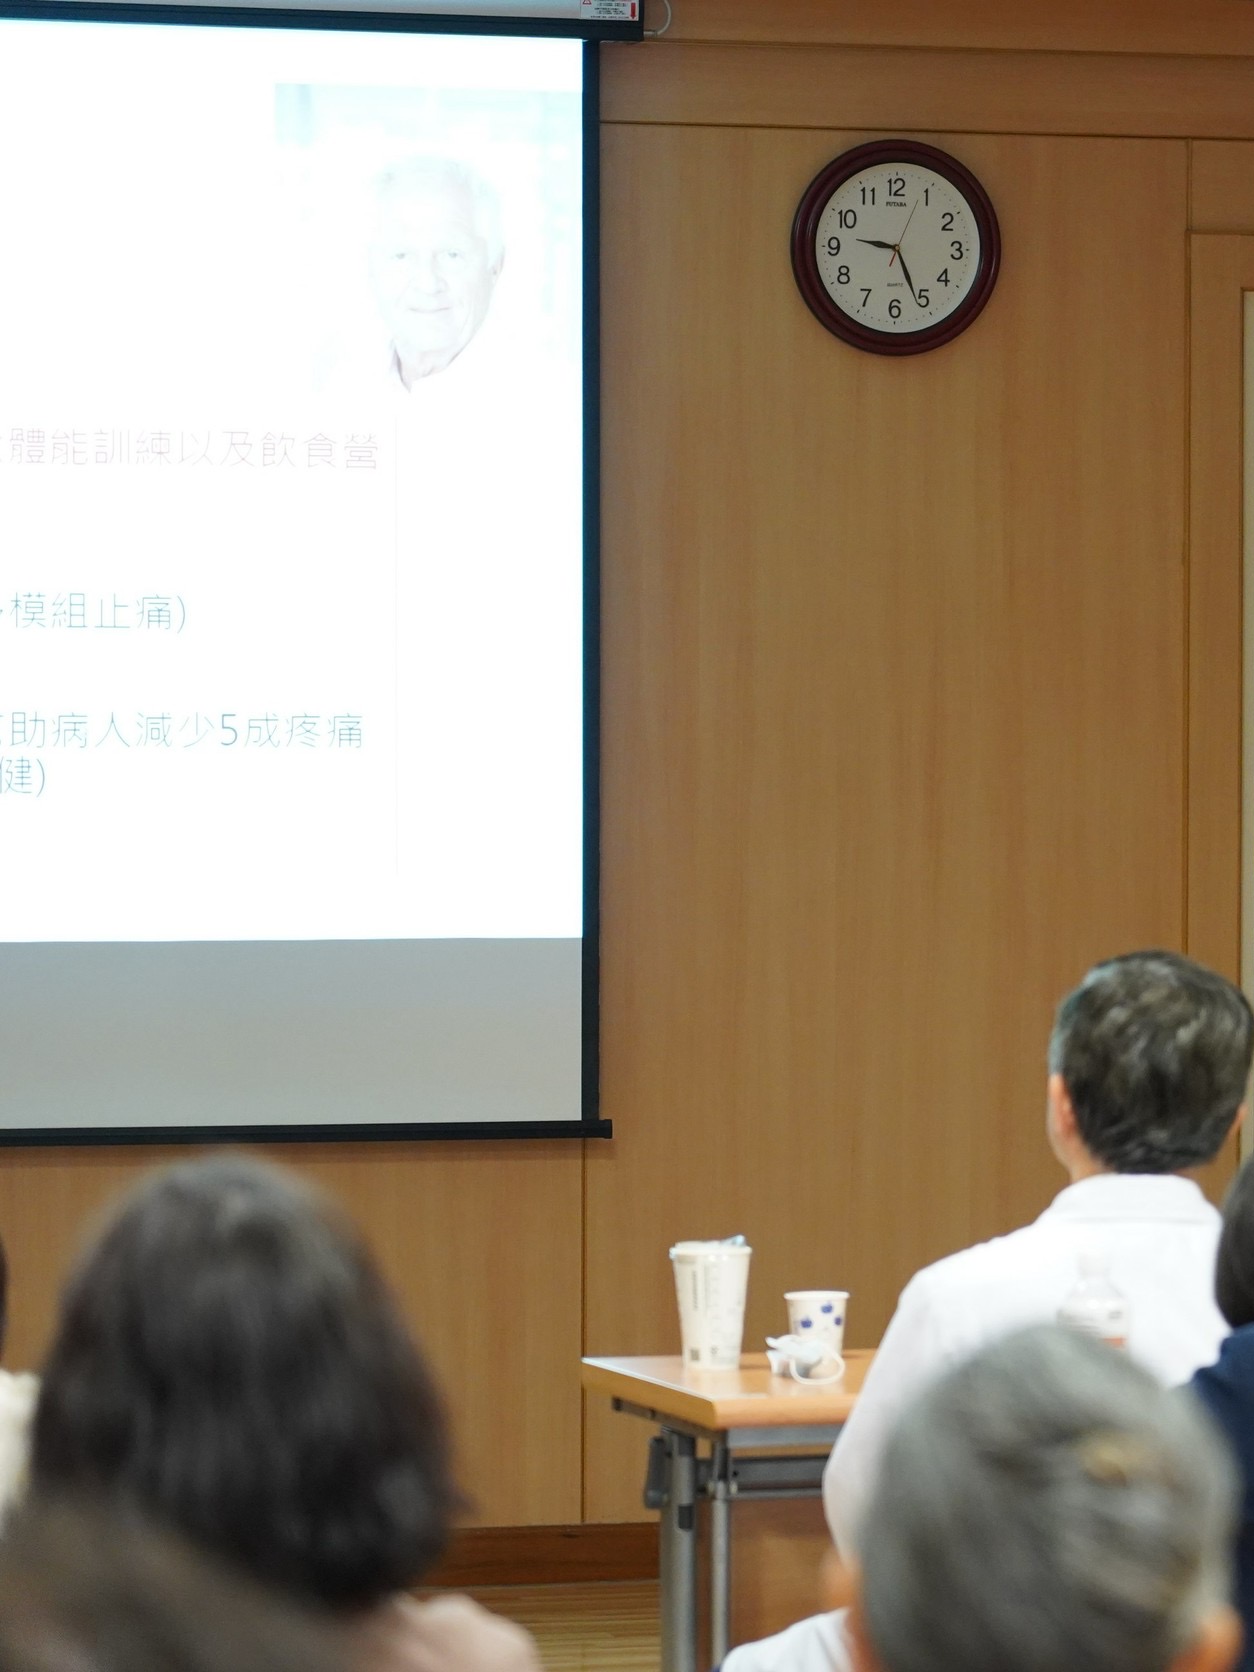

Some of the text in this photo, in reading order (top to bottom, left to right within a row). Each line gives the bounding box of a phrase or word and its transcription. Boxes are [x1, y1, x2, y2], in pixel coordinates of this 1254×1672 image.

[860, 186, 876, 206] 11
[887, 177, 906, 197] 12
[923, 187, 930, 206] 1
[837, 208, 857, 229] 10
[941, 212, 954, 231] 2
[827, 236, 841, 256] 9
[950, 240, 964, 260] 3
[837, 265, 850, 285] 8
[936, 267, 950, 287] 4
[860, 288, 872, 307] 7
[917, 289, 930, 308] 5
[888, 298, 902, 319] 6
[0, 427, 379, 470] 體能訓練以及飲食營
[0, 592, 187, 634] 模組止痛)
[0, 711, 364, 748] 助病人減少5成疼痛
